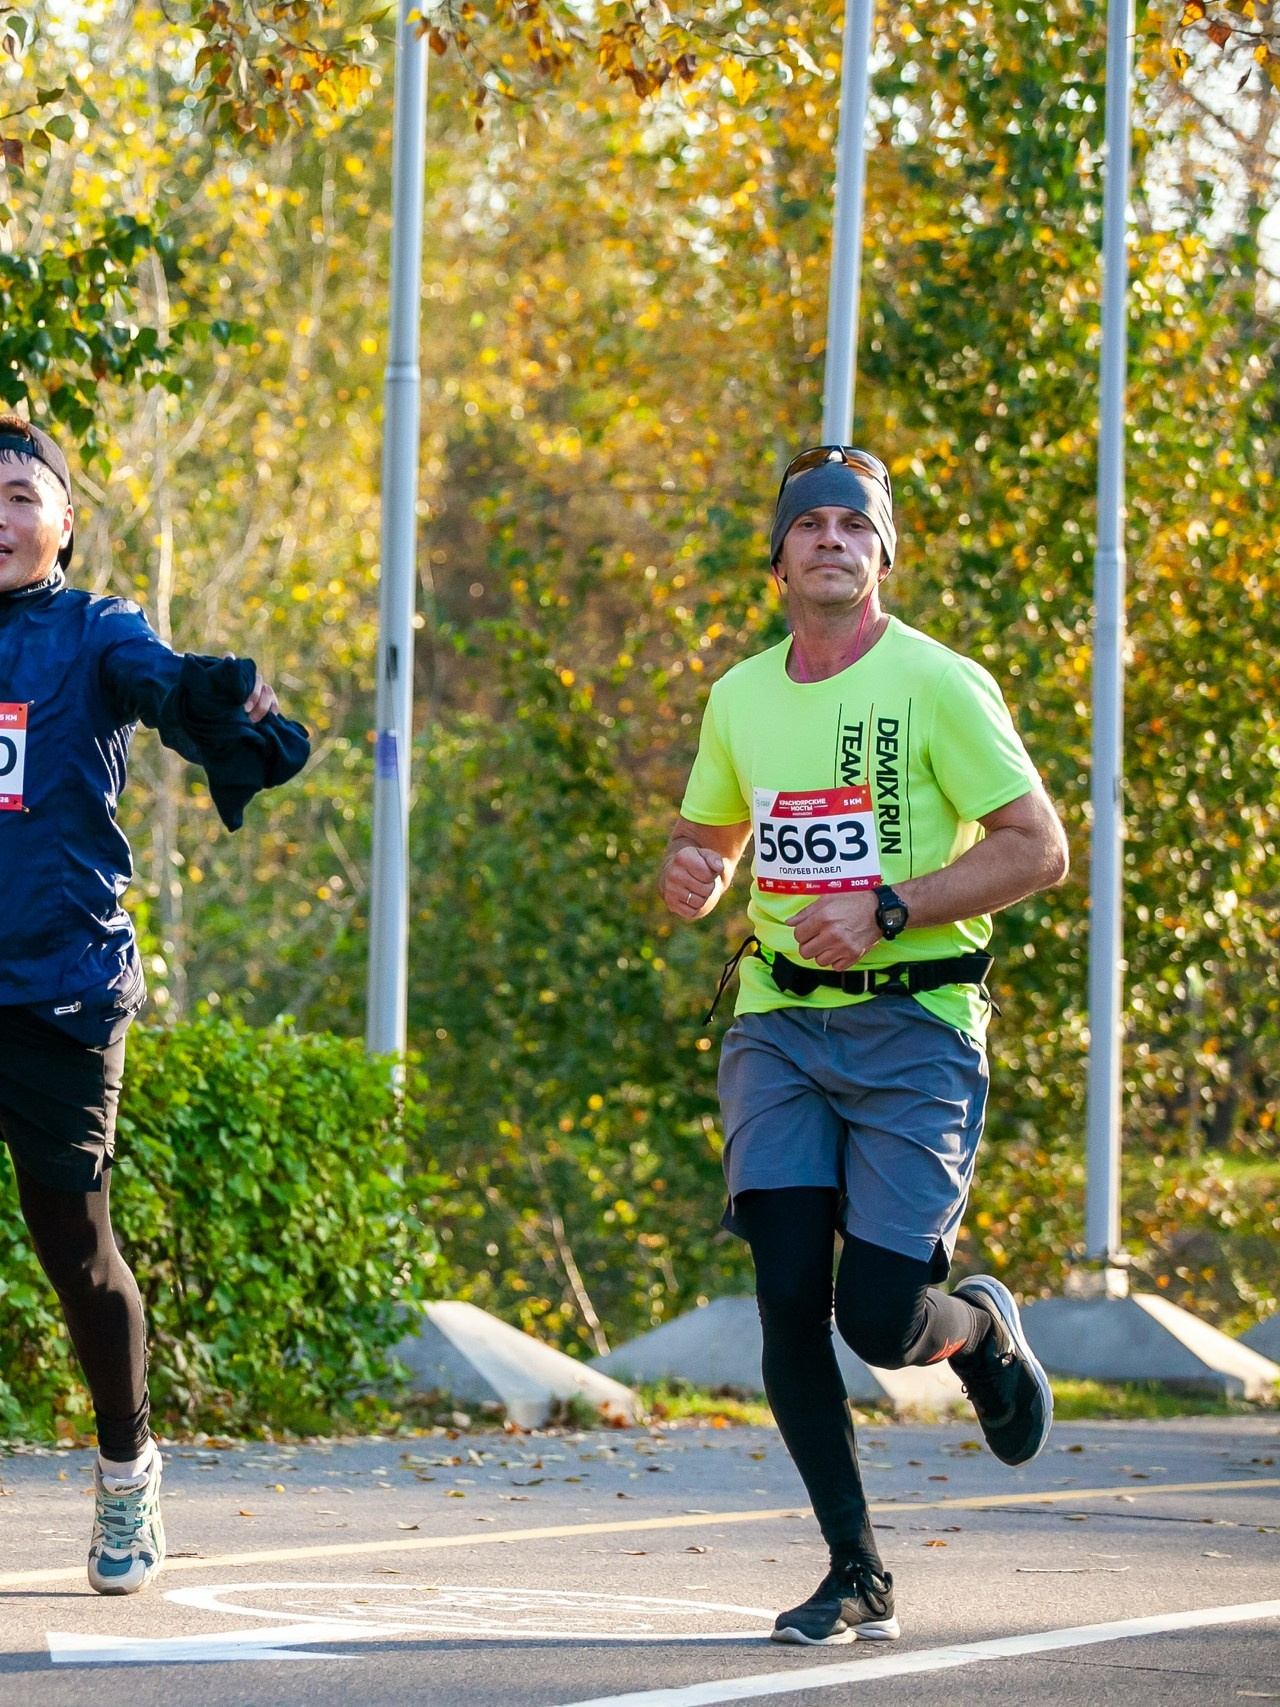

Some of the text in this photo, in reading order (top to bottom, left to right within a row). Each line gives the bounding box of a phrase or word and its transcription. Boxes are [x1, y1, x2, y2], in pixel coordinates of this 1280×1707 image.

[876, 717, 902, 854] DEMIX RUN
[759, 820, 869, 864] 5663
[780, 866, 842, 875] ГОЛУБЕВ ПАВЕЛ
